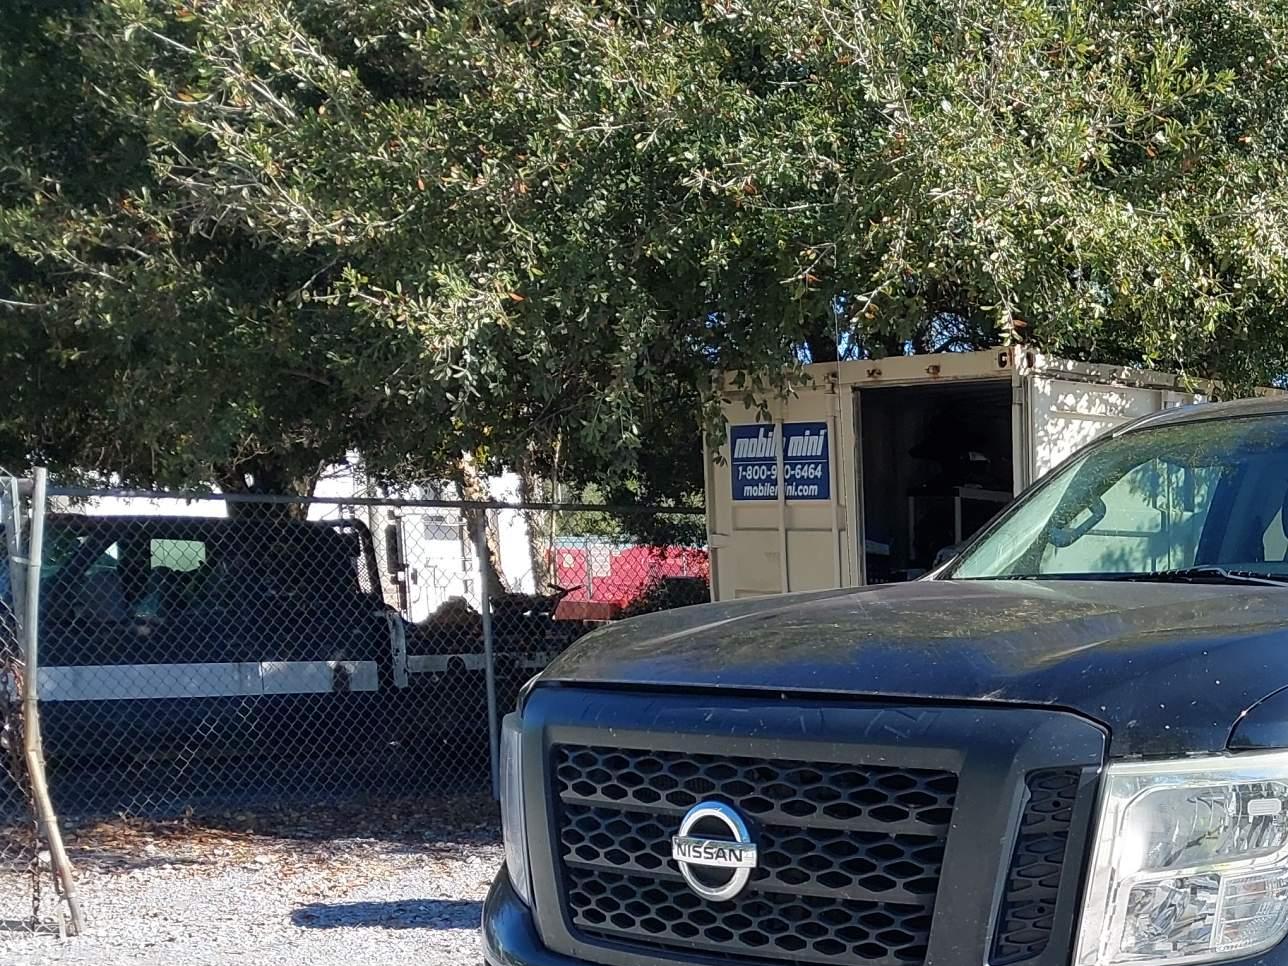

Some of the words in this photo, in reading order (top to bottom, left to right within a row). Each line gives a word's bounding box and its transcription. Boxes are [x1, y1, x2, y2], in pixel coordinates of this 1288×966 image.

[734, 428, 786, 458] mobil
[788, 430, 825, 457] mini
[738, 464, 822, 480] 1-800-90-6464
[676, 843, 743, 862] NISSAN
